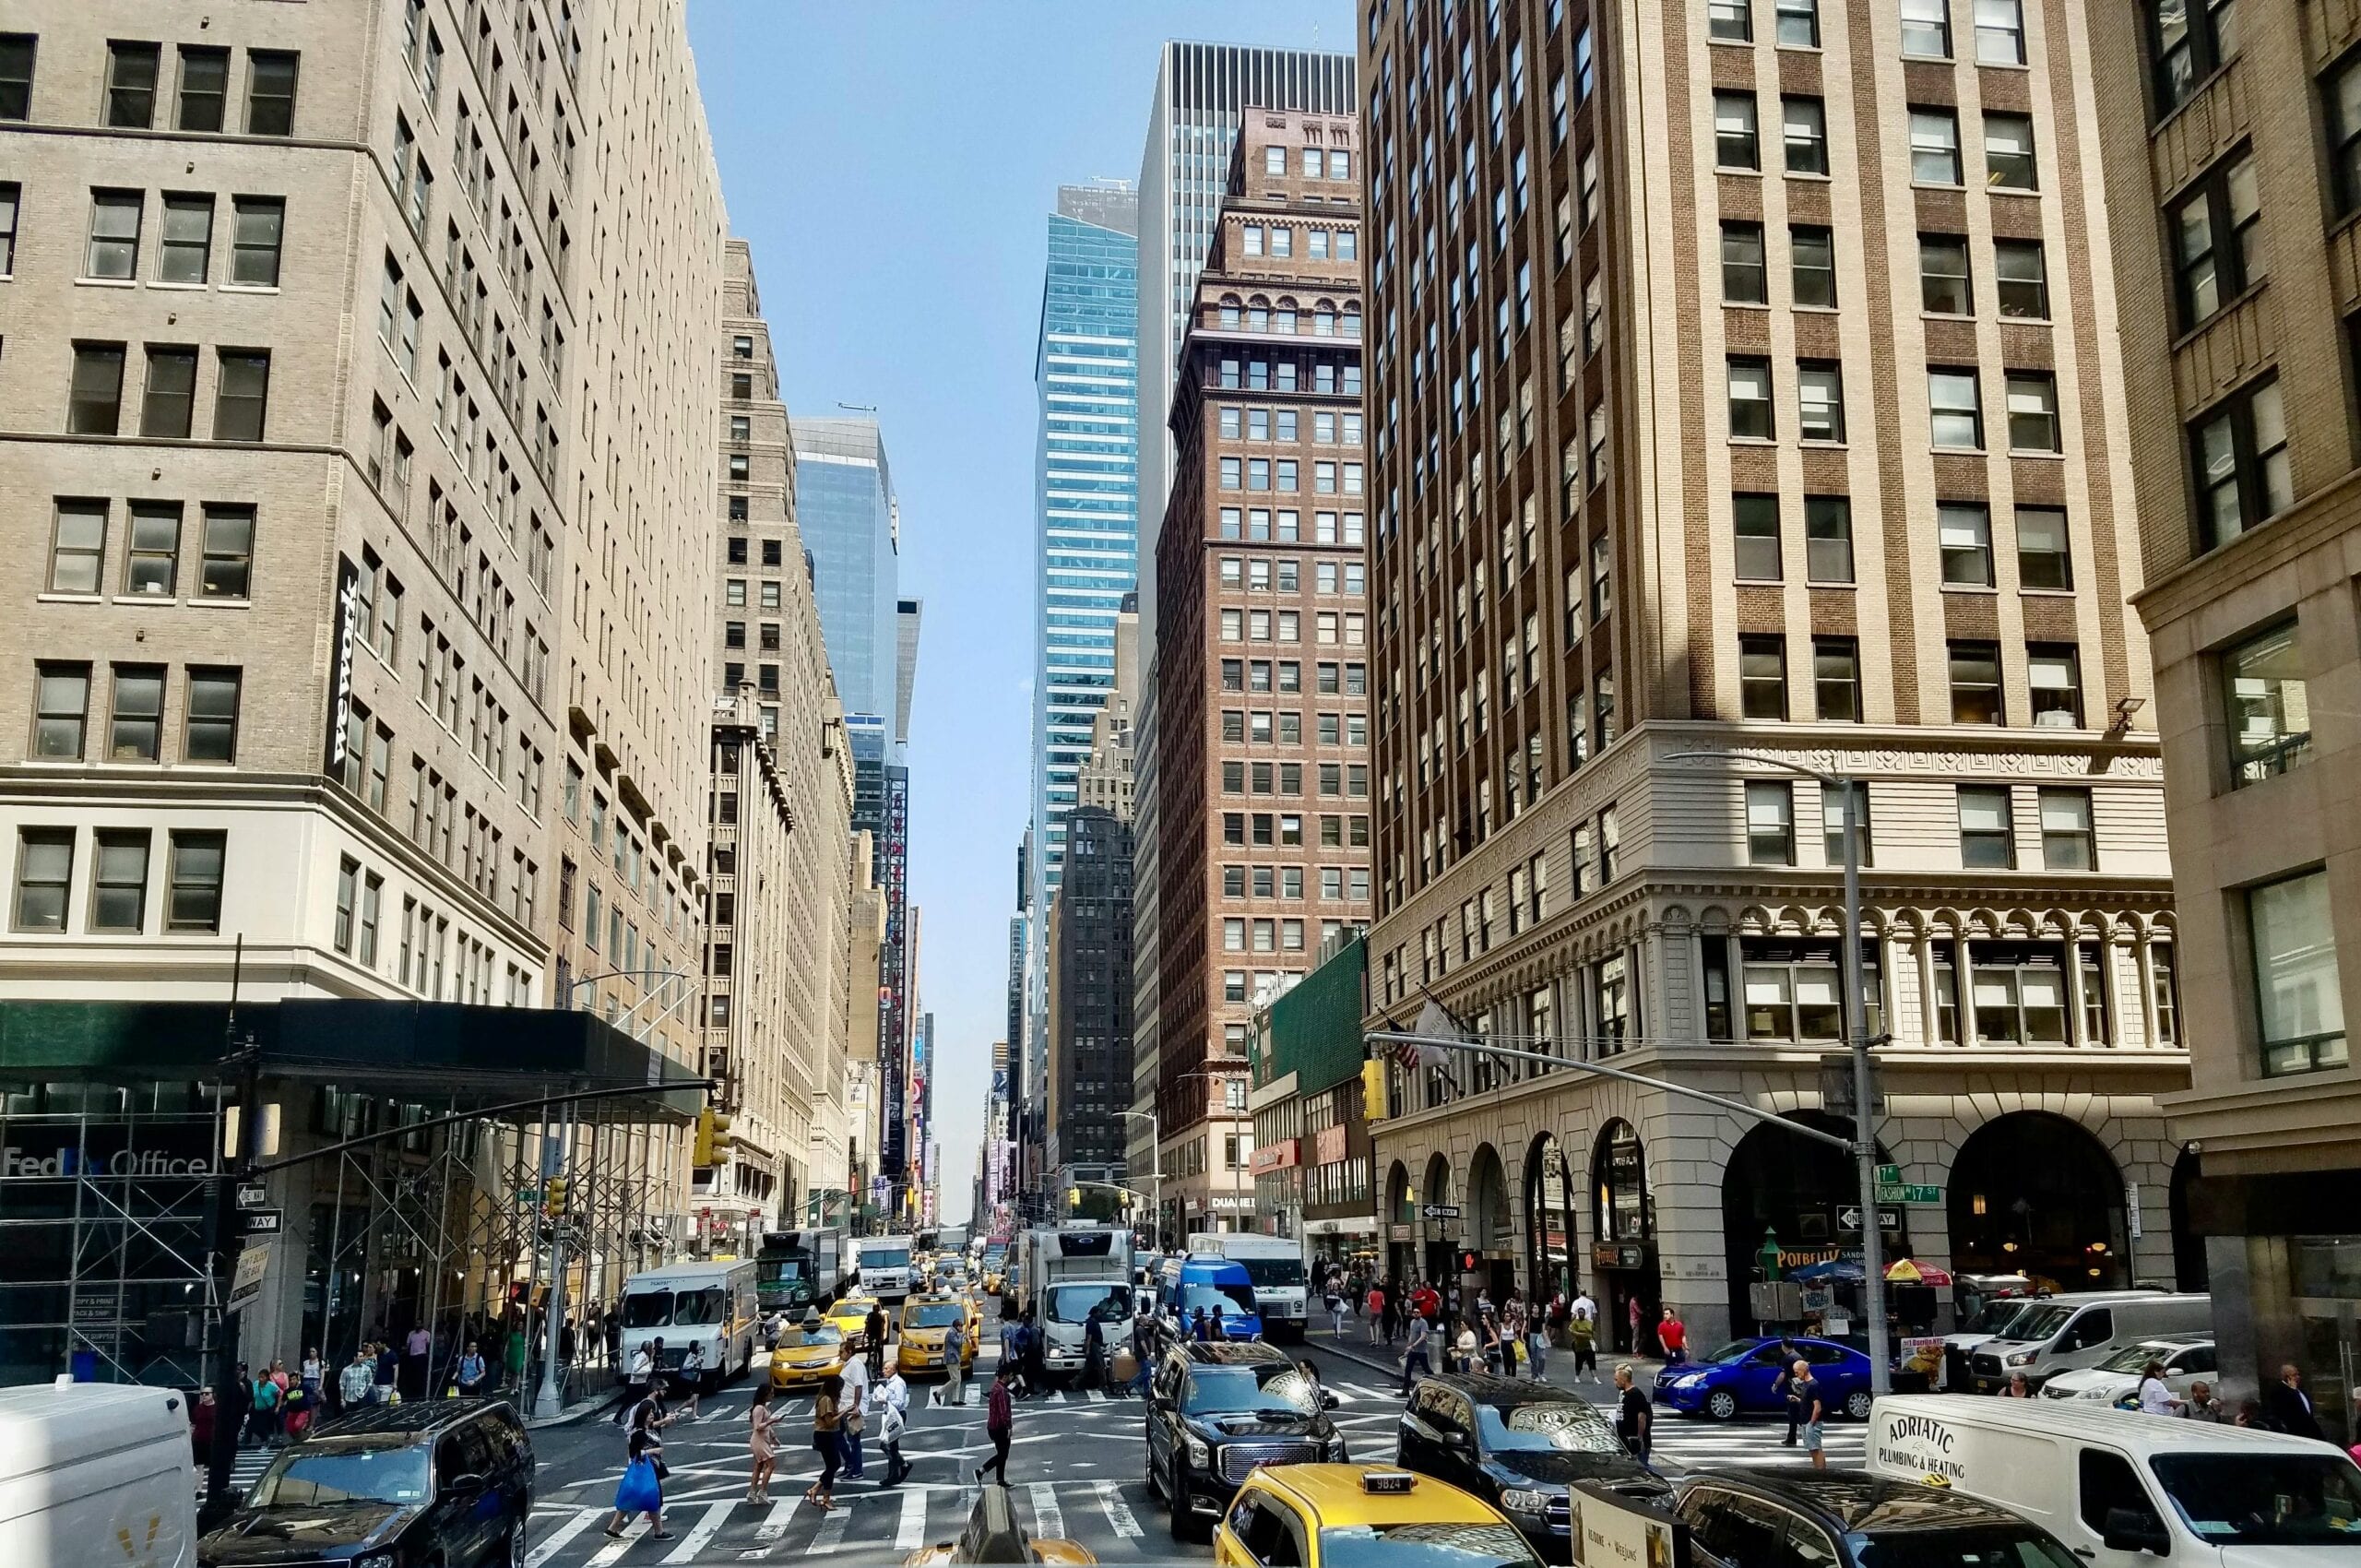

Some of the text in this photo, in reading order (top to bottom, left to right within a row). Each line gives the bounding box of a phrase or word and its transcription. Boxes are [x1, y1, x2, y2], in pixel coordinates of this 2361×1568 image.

[333, 575, 357, 764] wework
[111, 1149, 208, 1178] Office
[1880, 1167, 1887, 1182] 7
[1881, 1185, 1905, 1200] FASHION
[248, 1218, 272, 1228] WAY
[1777, 1249, 1840, 1267] POTBELLY
[1890, 1416, 1954, 1455] ADRIATIC
[1879, 1447, 1965, 1479] PLUMBING & HEATING
[1377, 1478, 1401, 1490] 9B24
